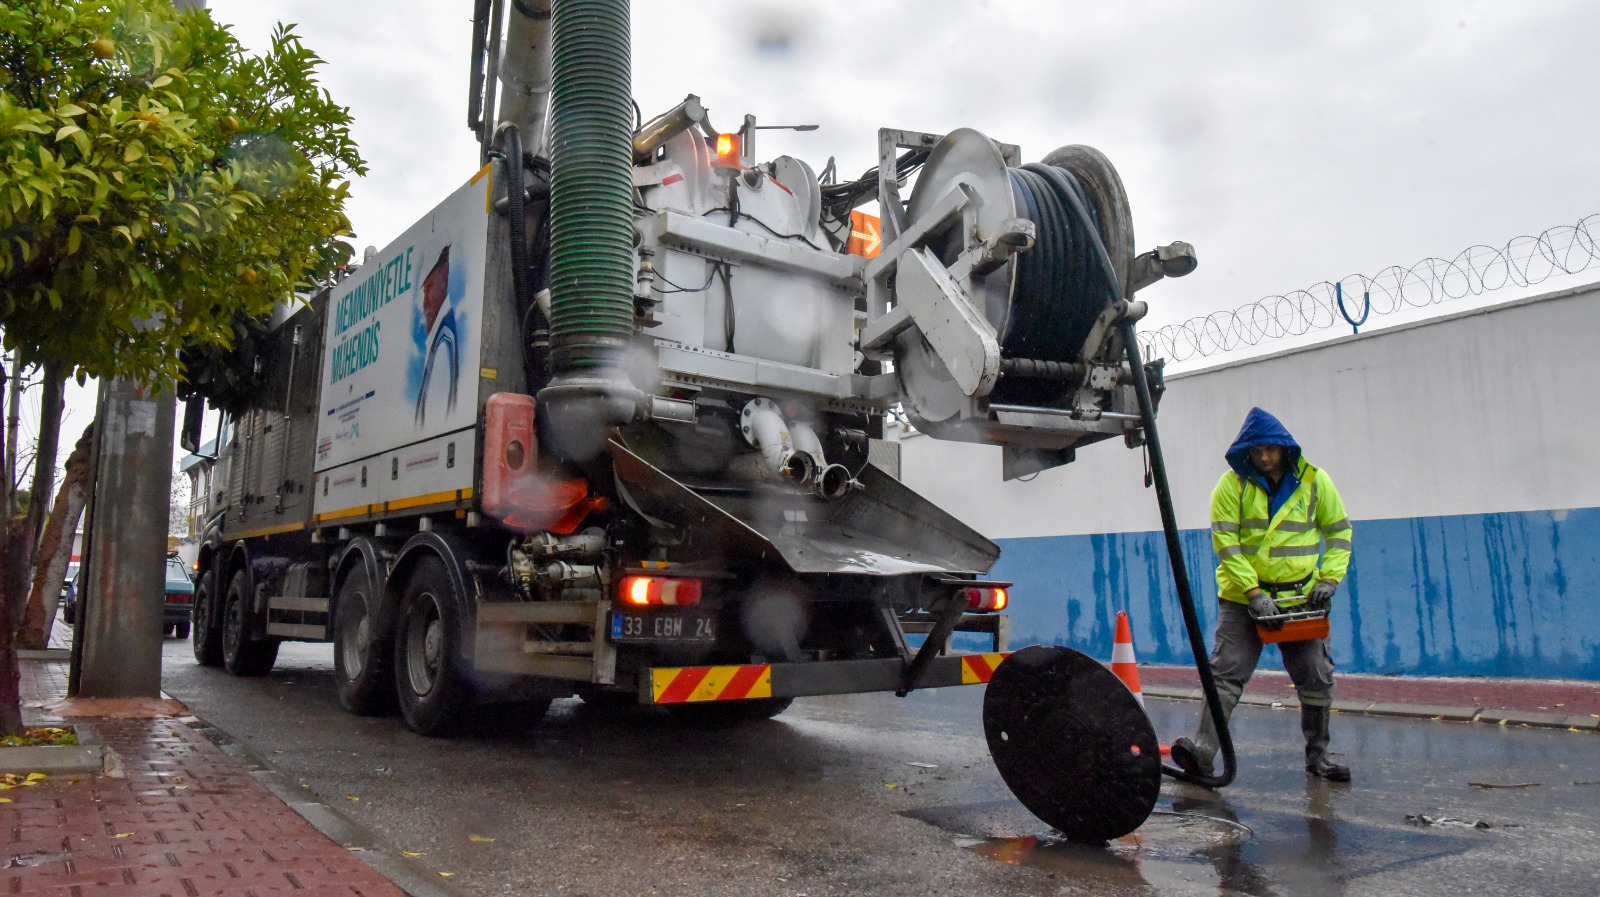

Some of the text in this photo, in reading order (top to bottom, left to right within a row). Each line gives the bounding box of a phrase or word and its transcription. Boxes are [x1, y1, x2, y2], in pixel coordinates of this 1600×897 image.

[334, 244, 414, 338] MEMNUNİYETLE
[330, 316, 381, 386] MÜHENDİS
[624, 616, 643, 636] 33
[695, 618, 713, 638] 24
